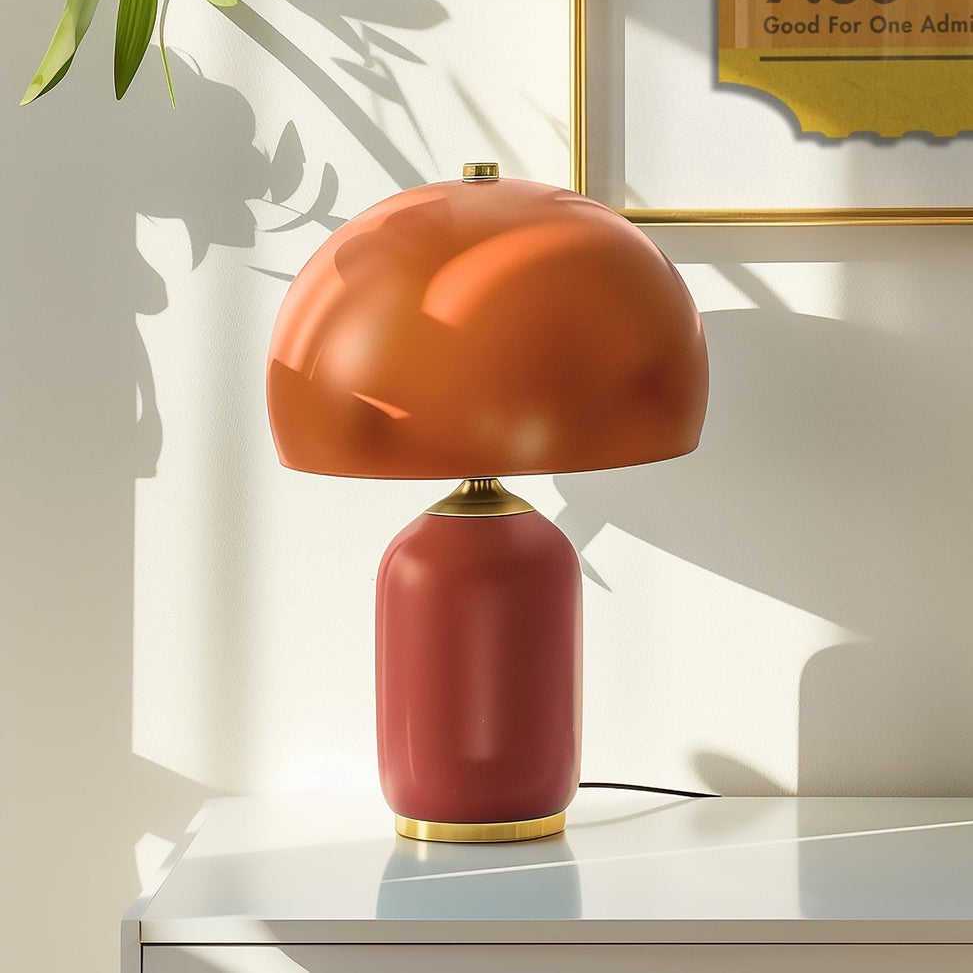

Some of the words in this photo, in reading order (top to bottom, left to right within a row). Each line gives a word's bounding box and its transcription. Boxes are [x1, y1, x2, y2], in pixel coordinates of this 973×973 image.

[764, 14, 819, 34] Good
[829, 16, 861, 33] For
[870, 15, 912, 33] One
